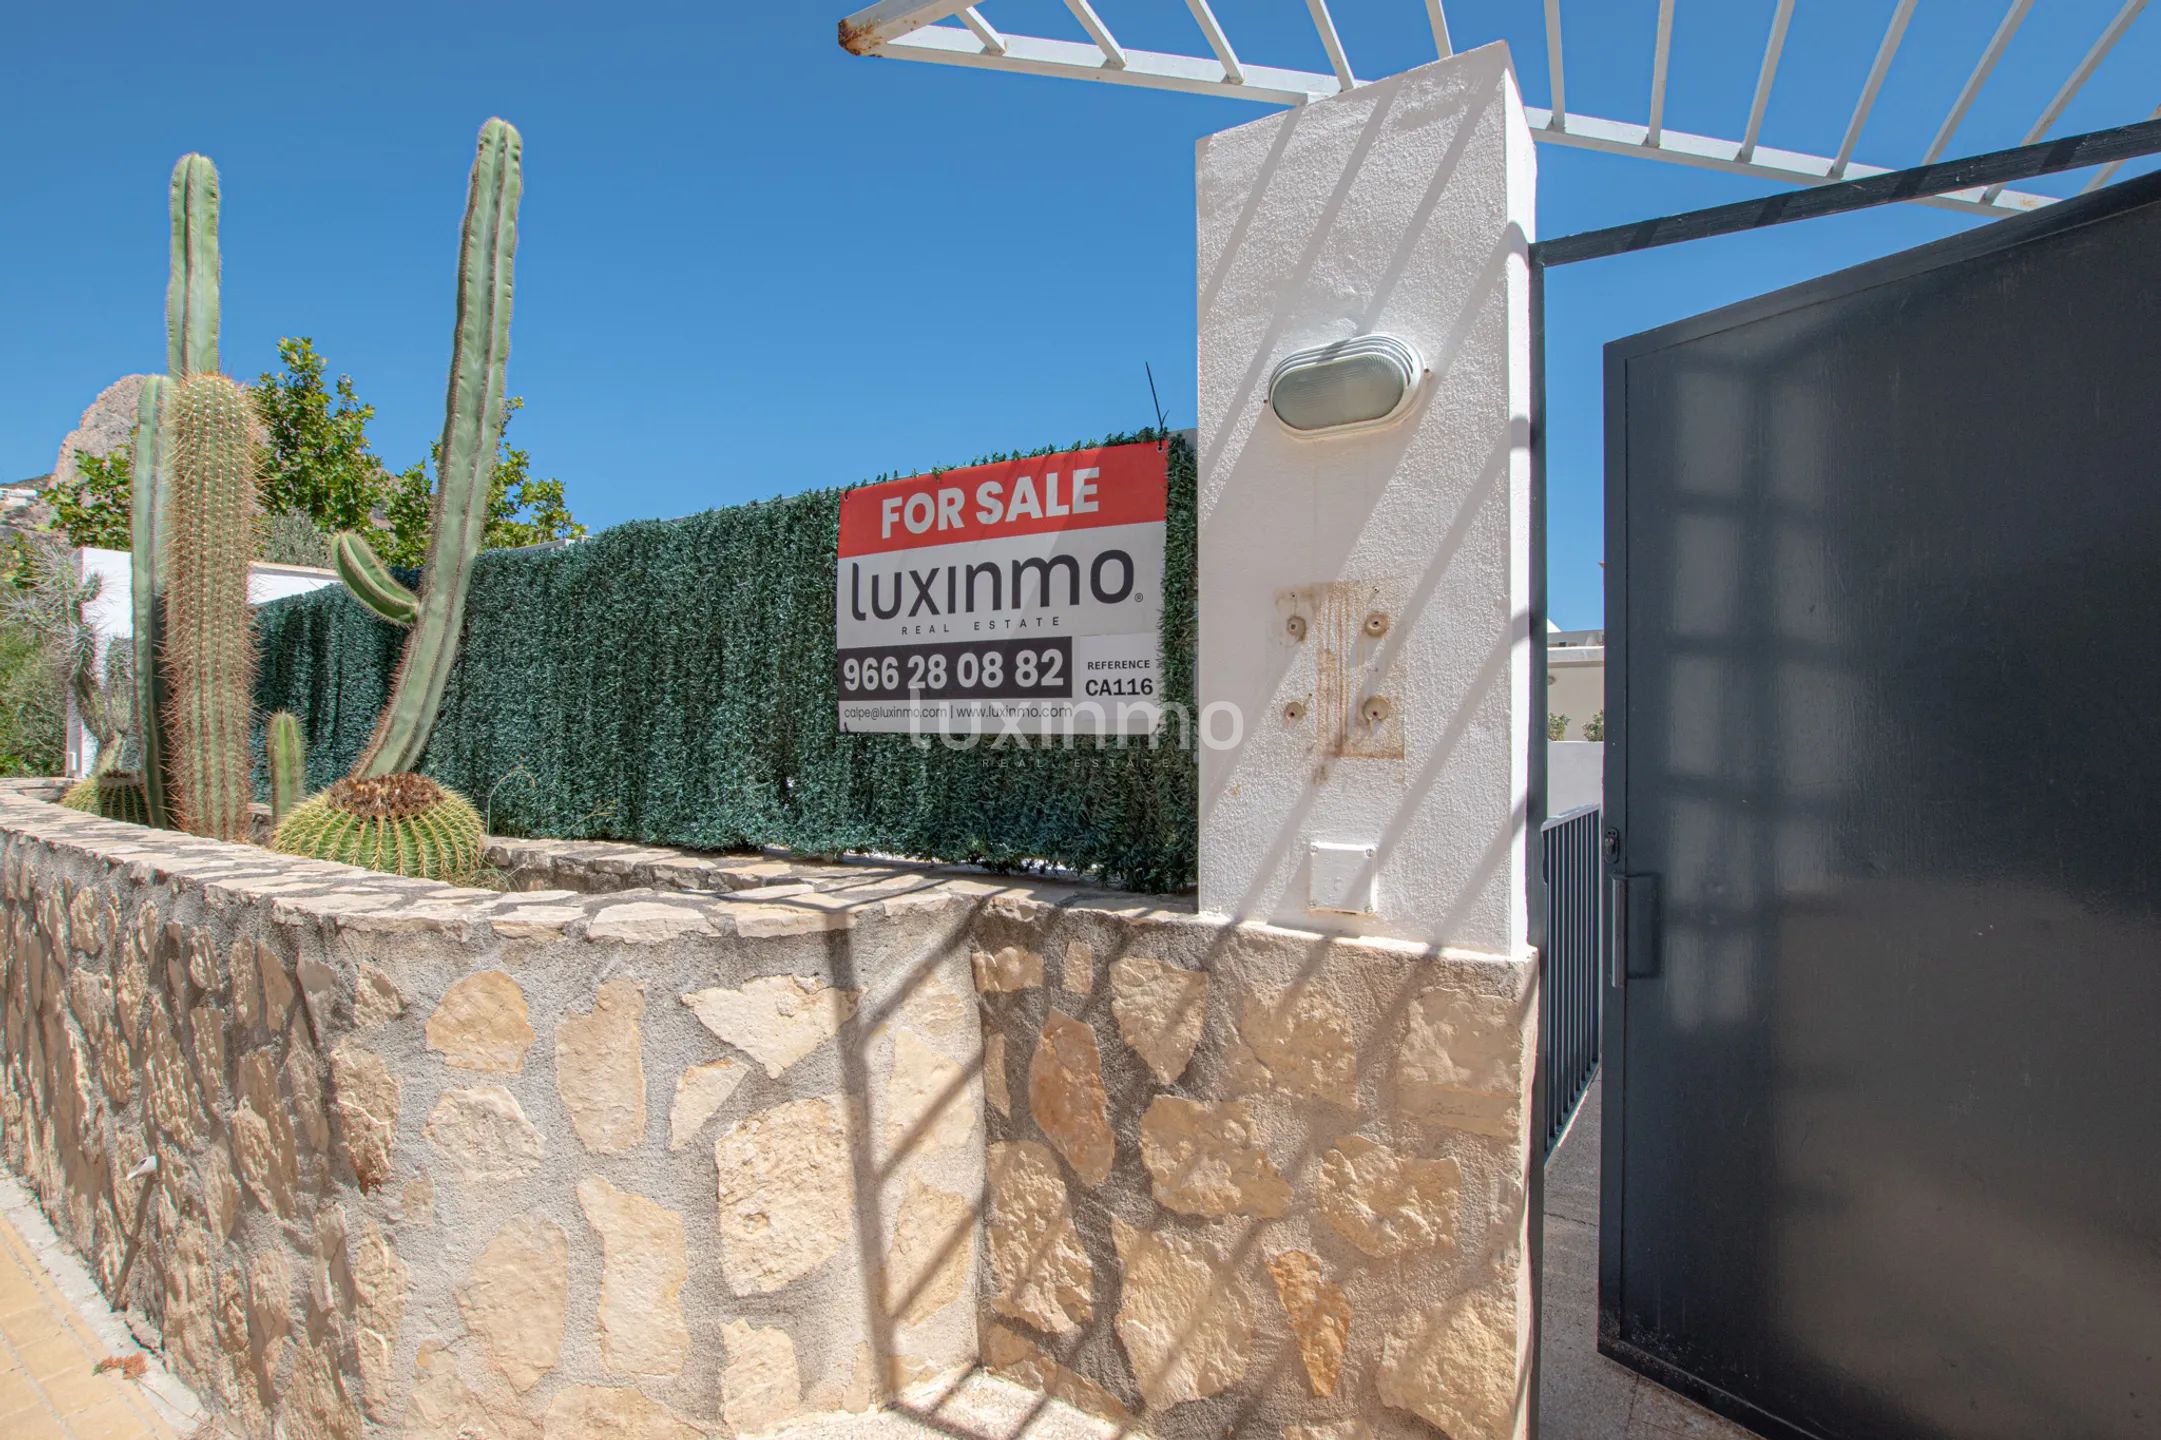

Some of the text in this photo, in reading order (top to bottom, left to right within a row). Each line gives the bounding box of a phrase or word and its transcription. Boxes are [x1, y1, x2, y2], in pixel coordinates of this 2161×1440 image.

[882, 467, 1099, 539] FOR SALE
[901, 617, 1060, 635] REAL ESTATE
[844, 649, 1064, 690] 966 28 08 82
[1087, 659, 1150, 671] REFERENCE
[1085, 678, 1154, 697] CA116
[844, 706, 947, 720] calpe@luxinmo.com
[957, 705, 1072, 718] www.luxinmo.com
